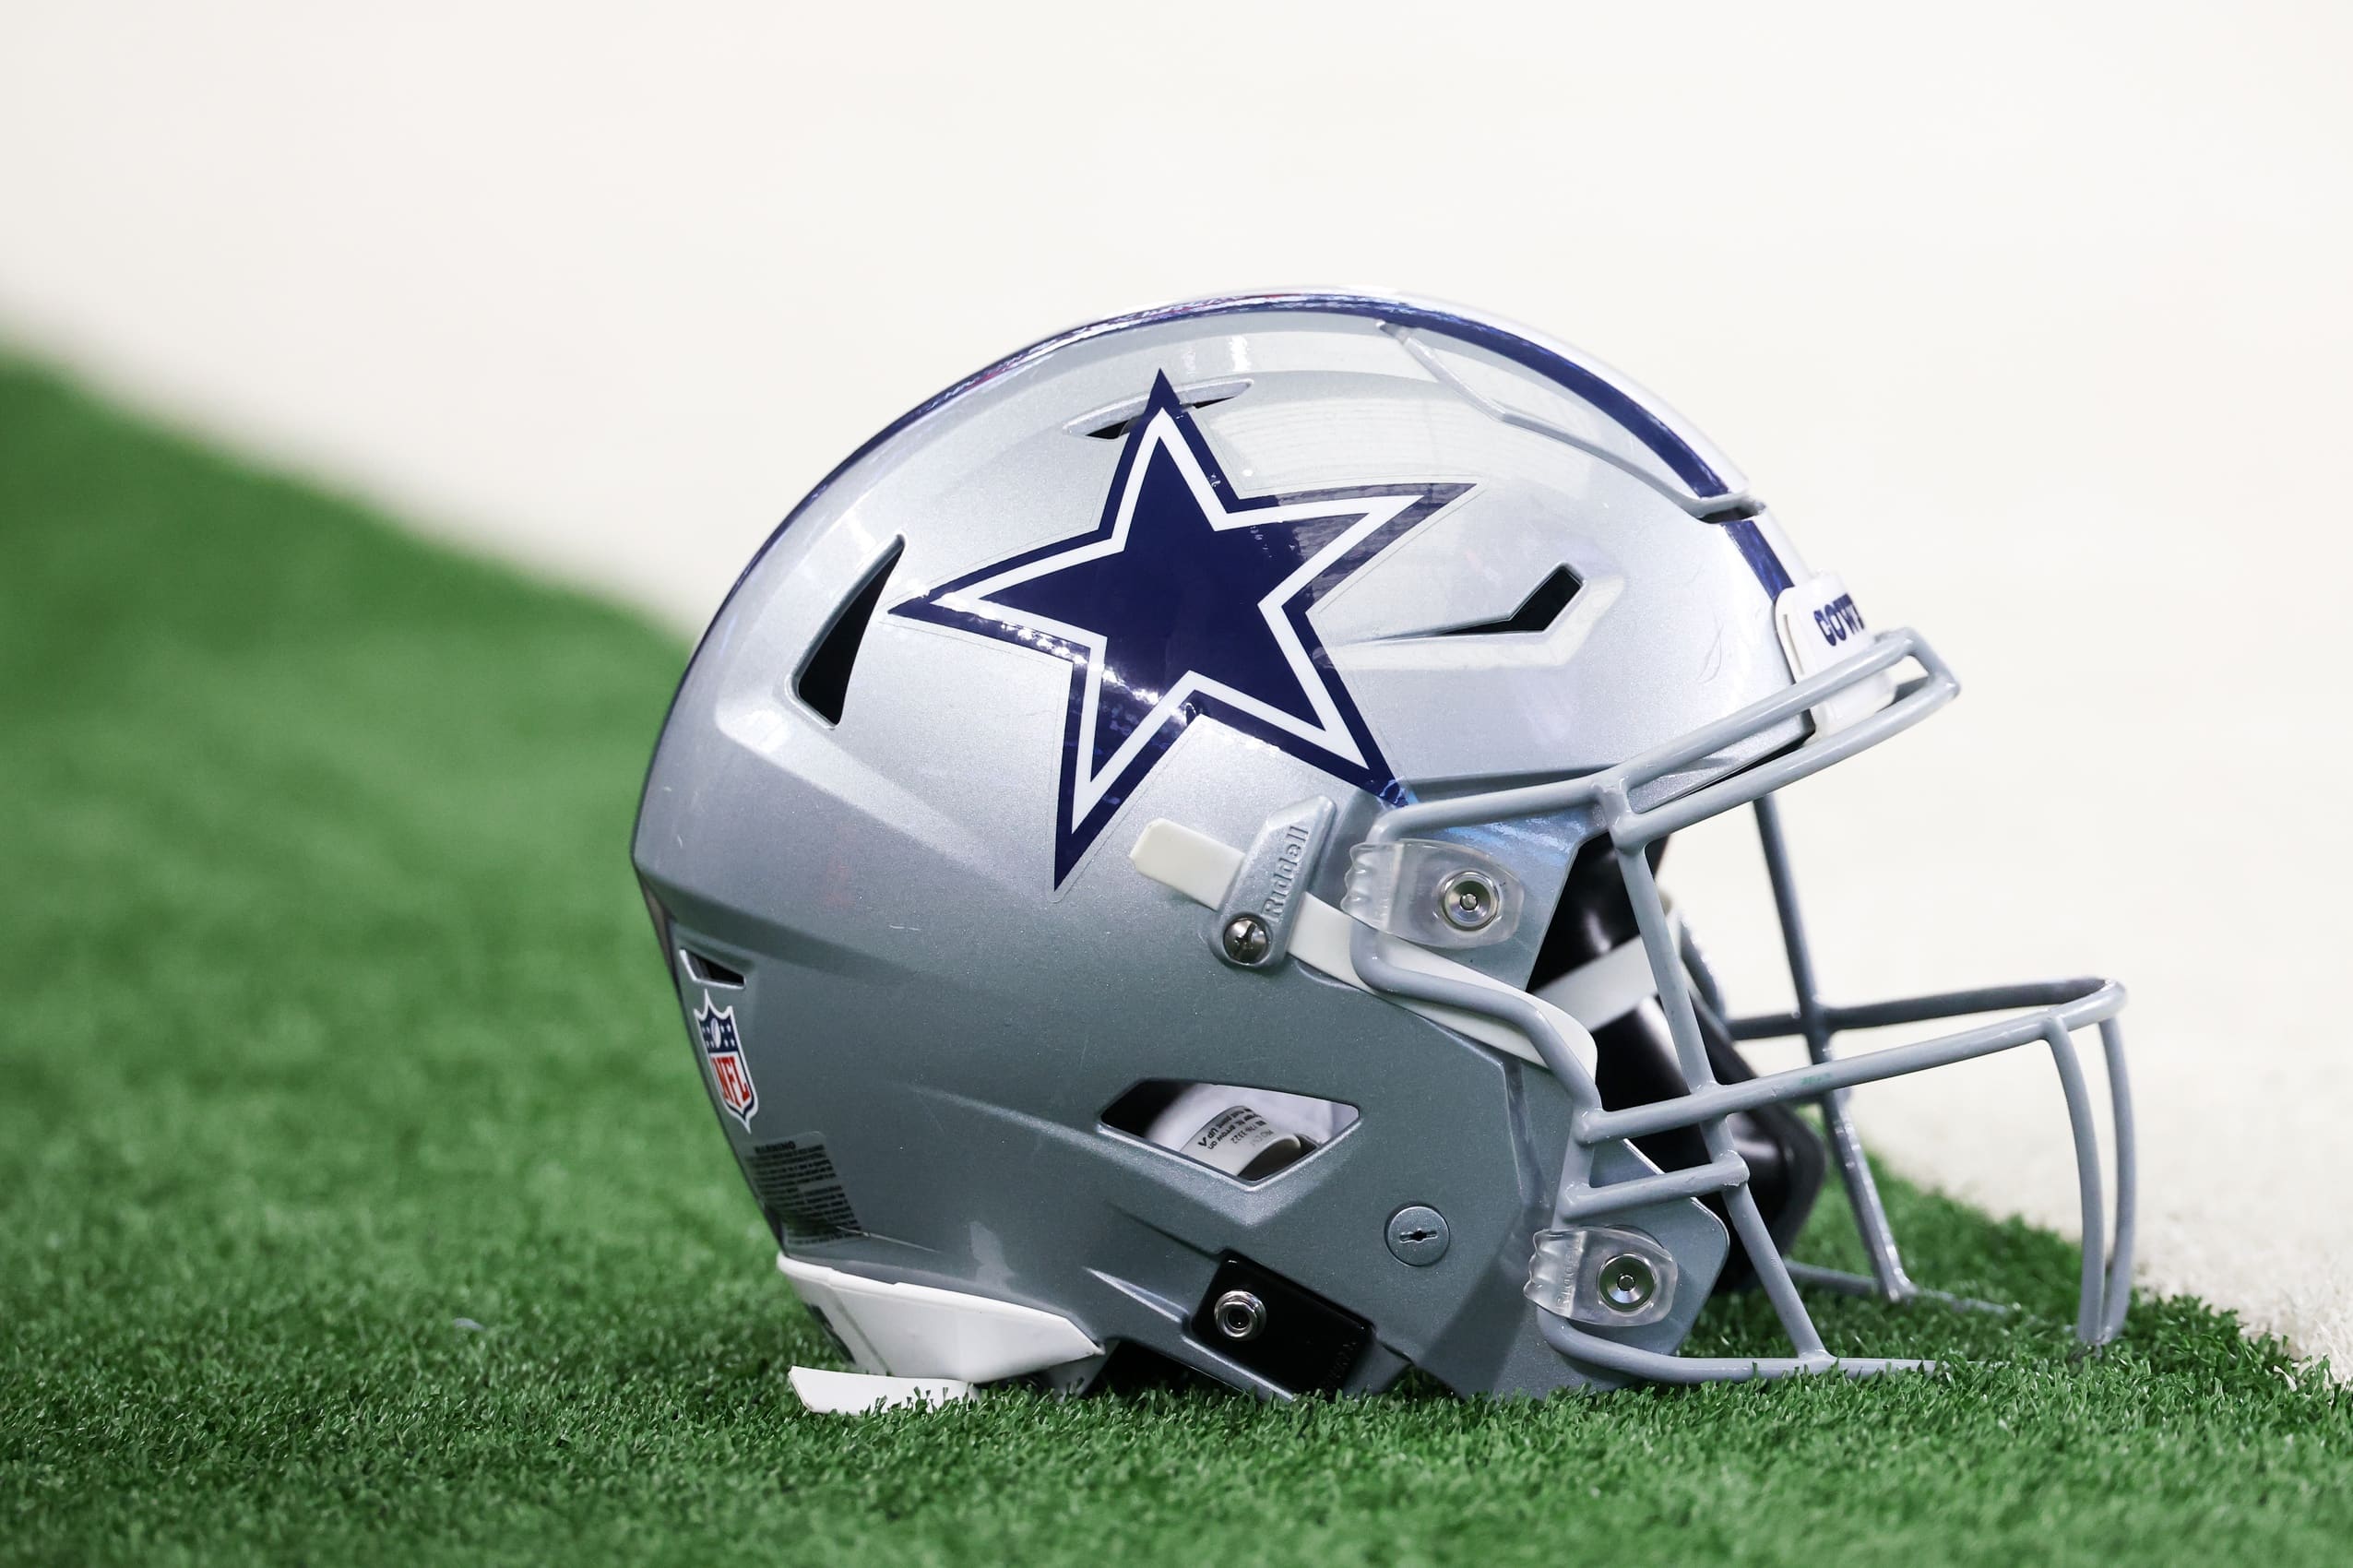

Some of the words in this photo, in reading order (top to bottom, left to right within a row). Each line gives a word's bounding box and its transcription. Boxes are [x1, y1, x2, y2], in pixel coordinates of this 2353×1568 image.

[1813, 593, 1864, 647] COW
[1261, 826, 1309, 922] Riddell
[712, 1056, 751, 1108] NFL
[1207, 1127, 1218, 1139] UP
